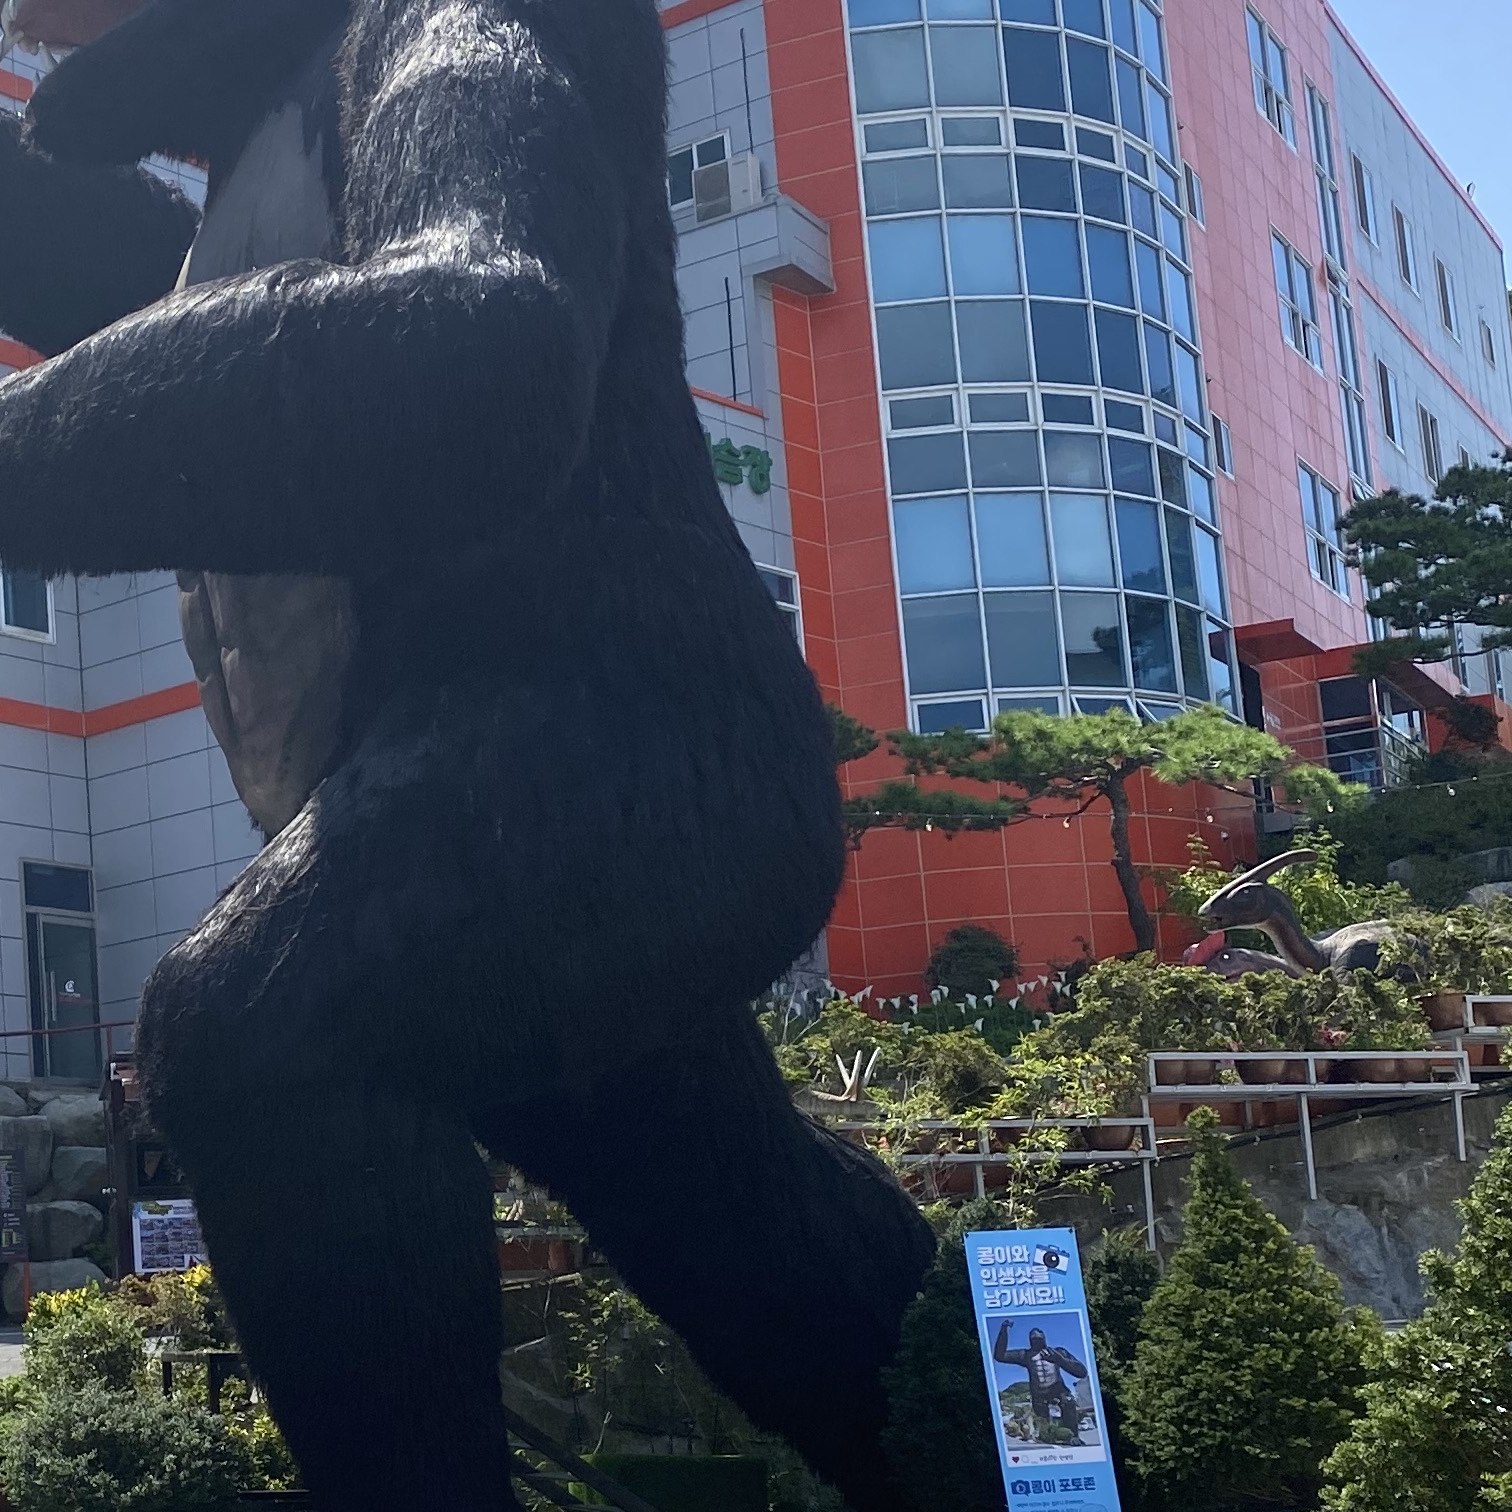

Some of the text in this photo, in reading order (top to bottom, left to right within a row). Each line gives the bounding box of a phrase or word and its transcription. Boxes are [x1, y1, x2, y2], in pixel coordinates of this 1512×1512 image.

[976, 1245, 1030, 1265] 콩이와
[980, 1265, 1051, 1287] 인생샷을
[984, 1286, 1066, 1308] 남기세요!!
[1031, 1477, 1096, 1495] 콩이 포토존
